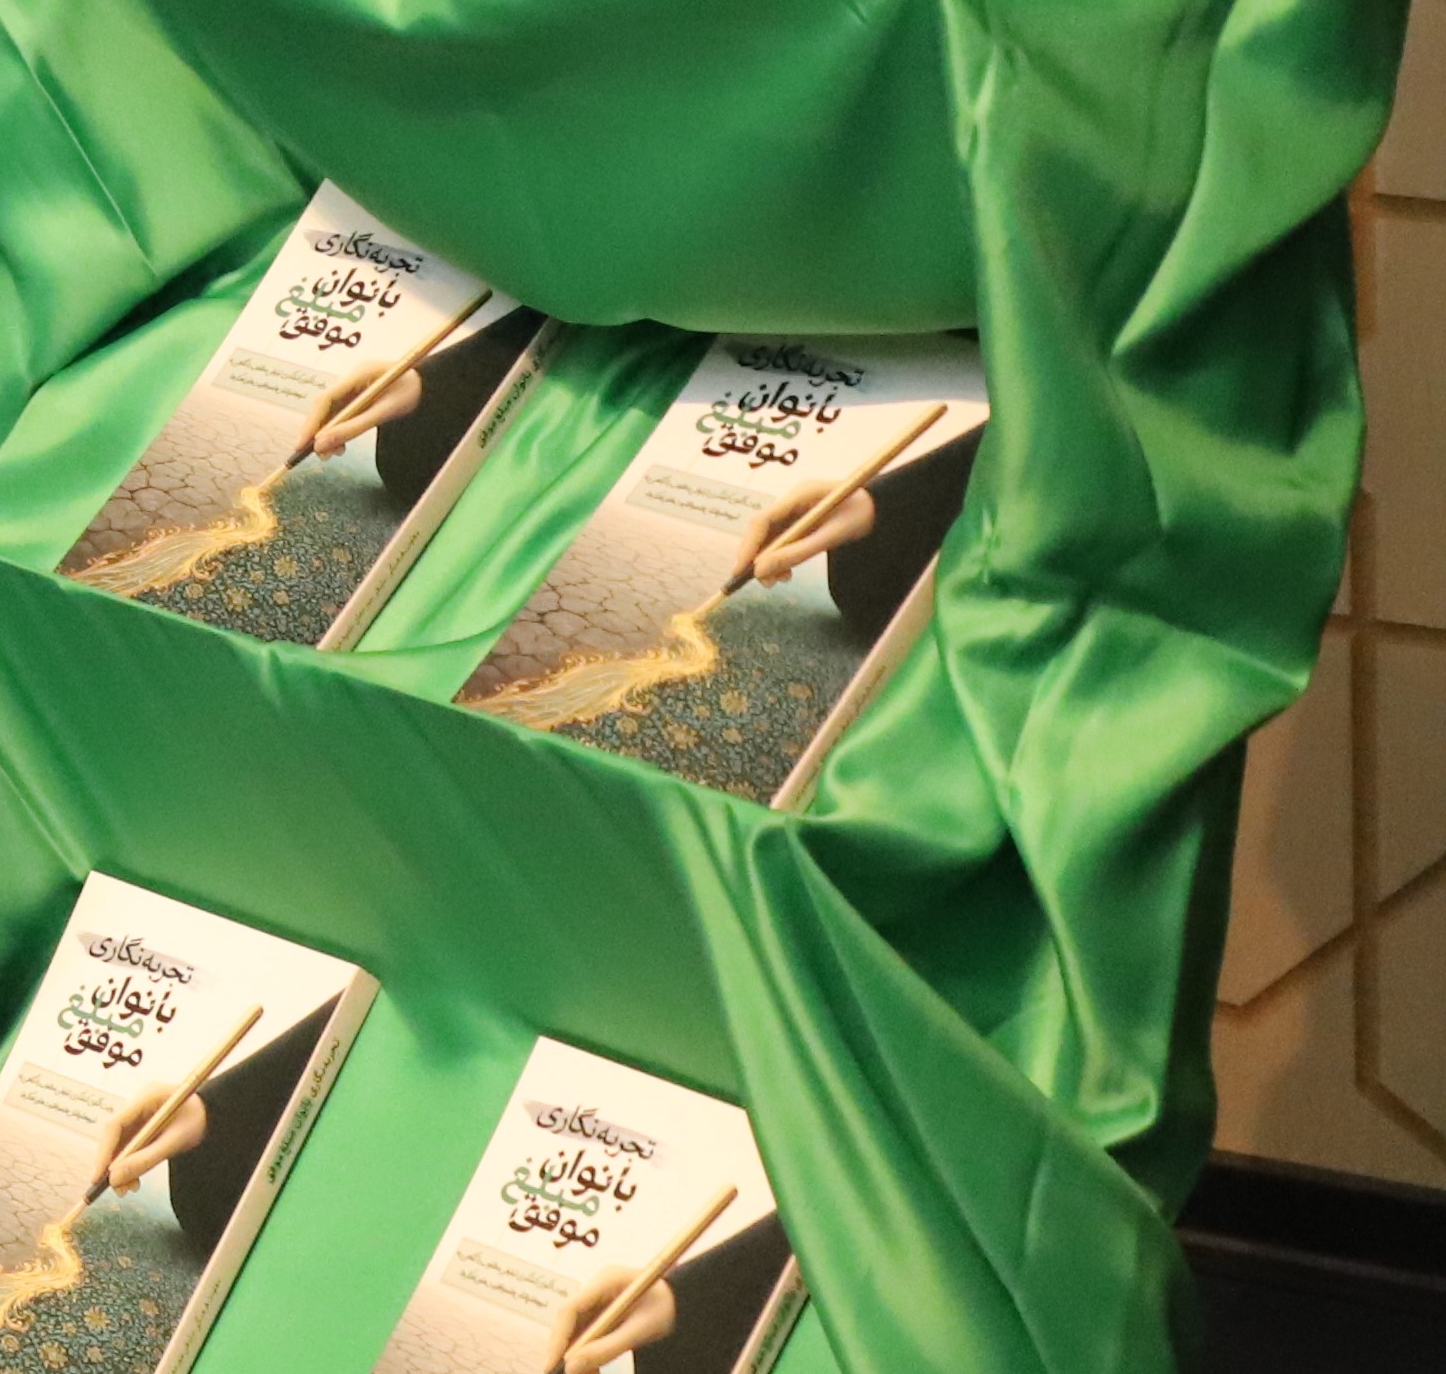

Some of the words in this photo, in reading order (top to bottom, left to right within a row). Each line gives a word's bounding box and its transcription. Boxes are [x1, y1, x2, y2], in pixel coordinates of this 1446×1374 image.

[274, 276, 366, 323] مبلغ
[311, 267, 402, 318] بانوان
[279, 307, 362, 351] موفق
[695, 391, 801, 439] مبلغ
[737, 381, 842, 433] بانوان
[701, 423, 799, 469] موفق
[57, 984, 144, 1039] مبلغ
[91, 976, 177, 1033] بانوان
[63, 1018, 144, 1069] موفق
[500, 1157, 601, 1217] مبلغ
[539, 1149, 638, 1212] بانوان
[508, 1192, 601, 1249] موفق
